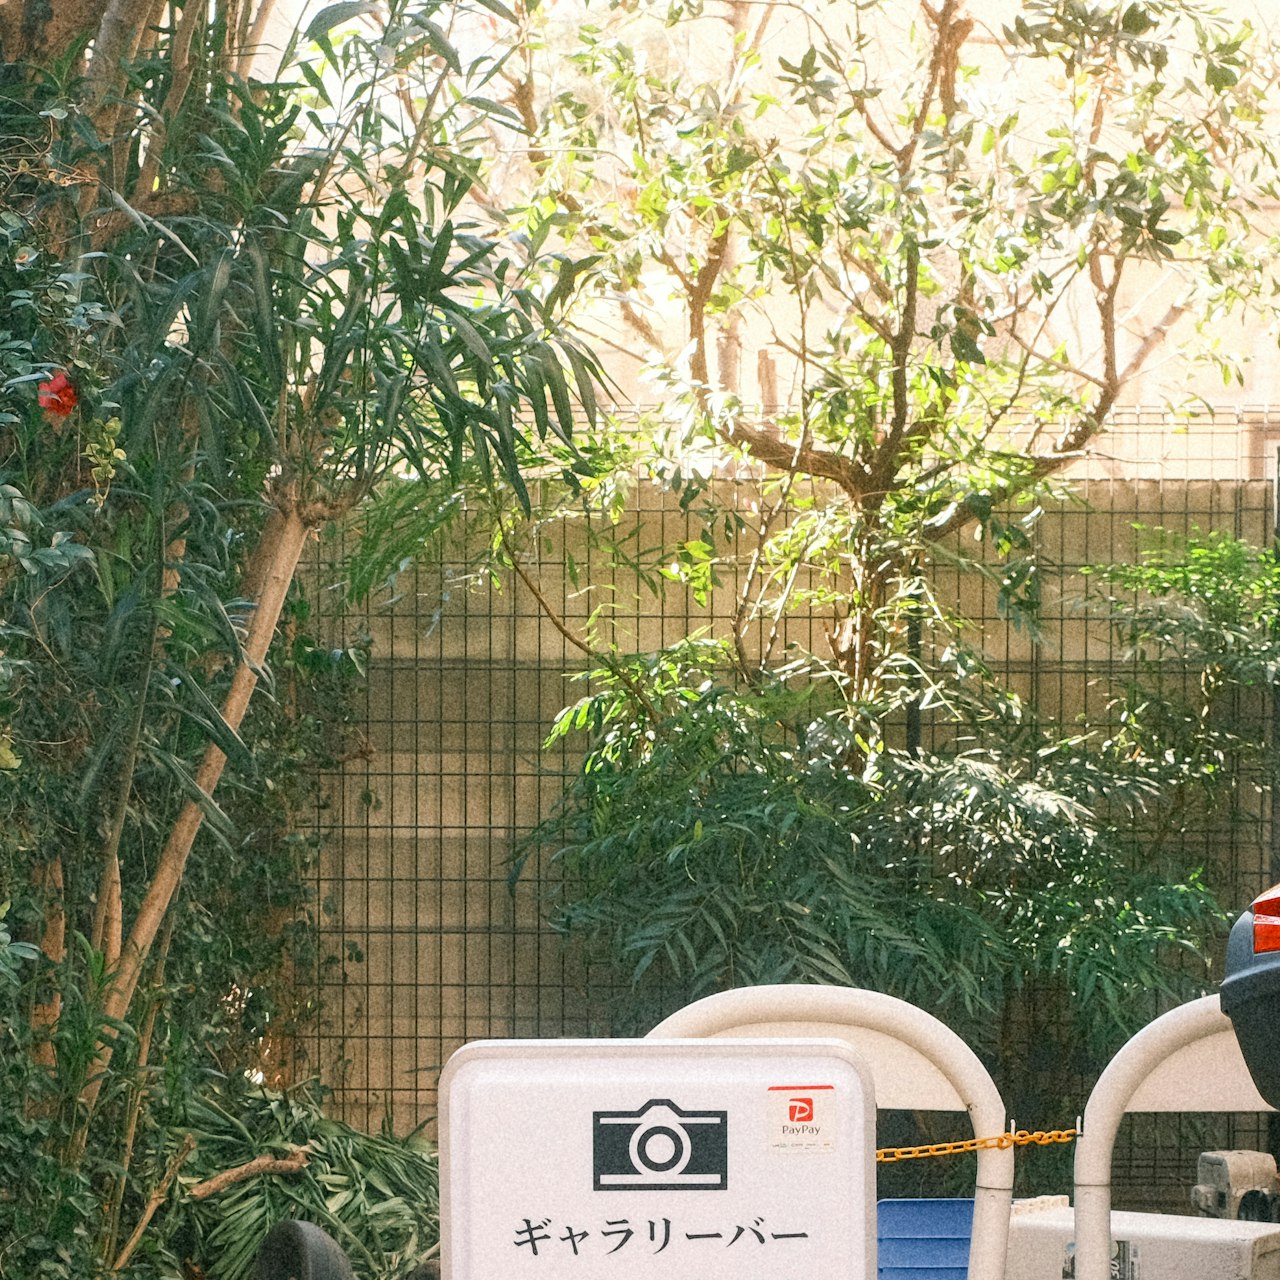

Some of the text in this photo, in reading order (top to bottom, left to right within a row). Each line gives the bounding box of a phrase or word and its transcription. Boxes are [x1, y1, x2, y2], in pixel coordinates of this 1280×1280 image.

[782, 1125, 821, 1136] PayPay
[513, 1216, 809, 1256] ギャラリーバー
